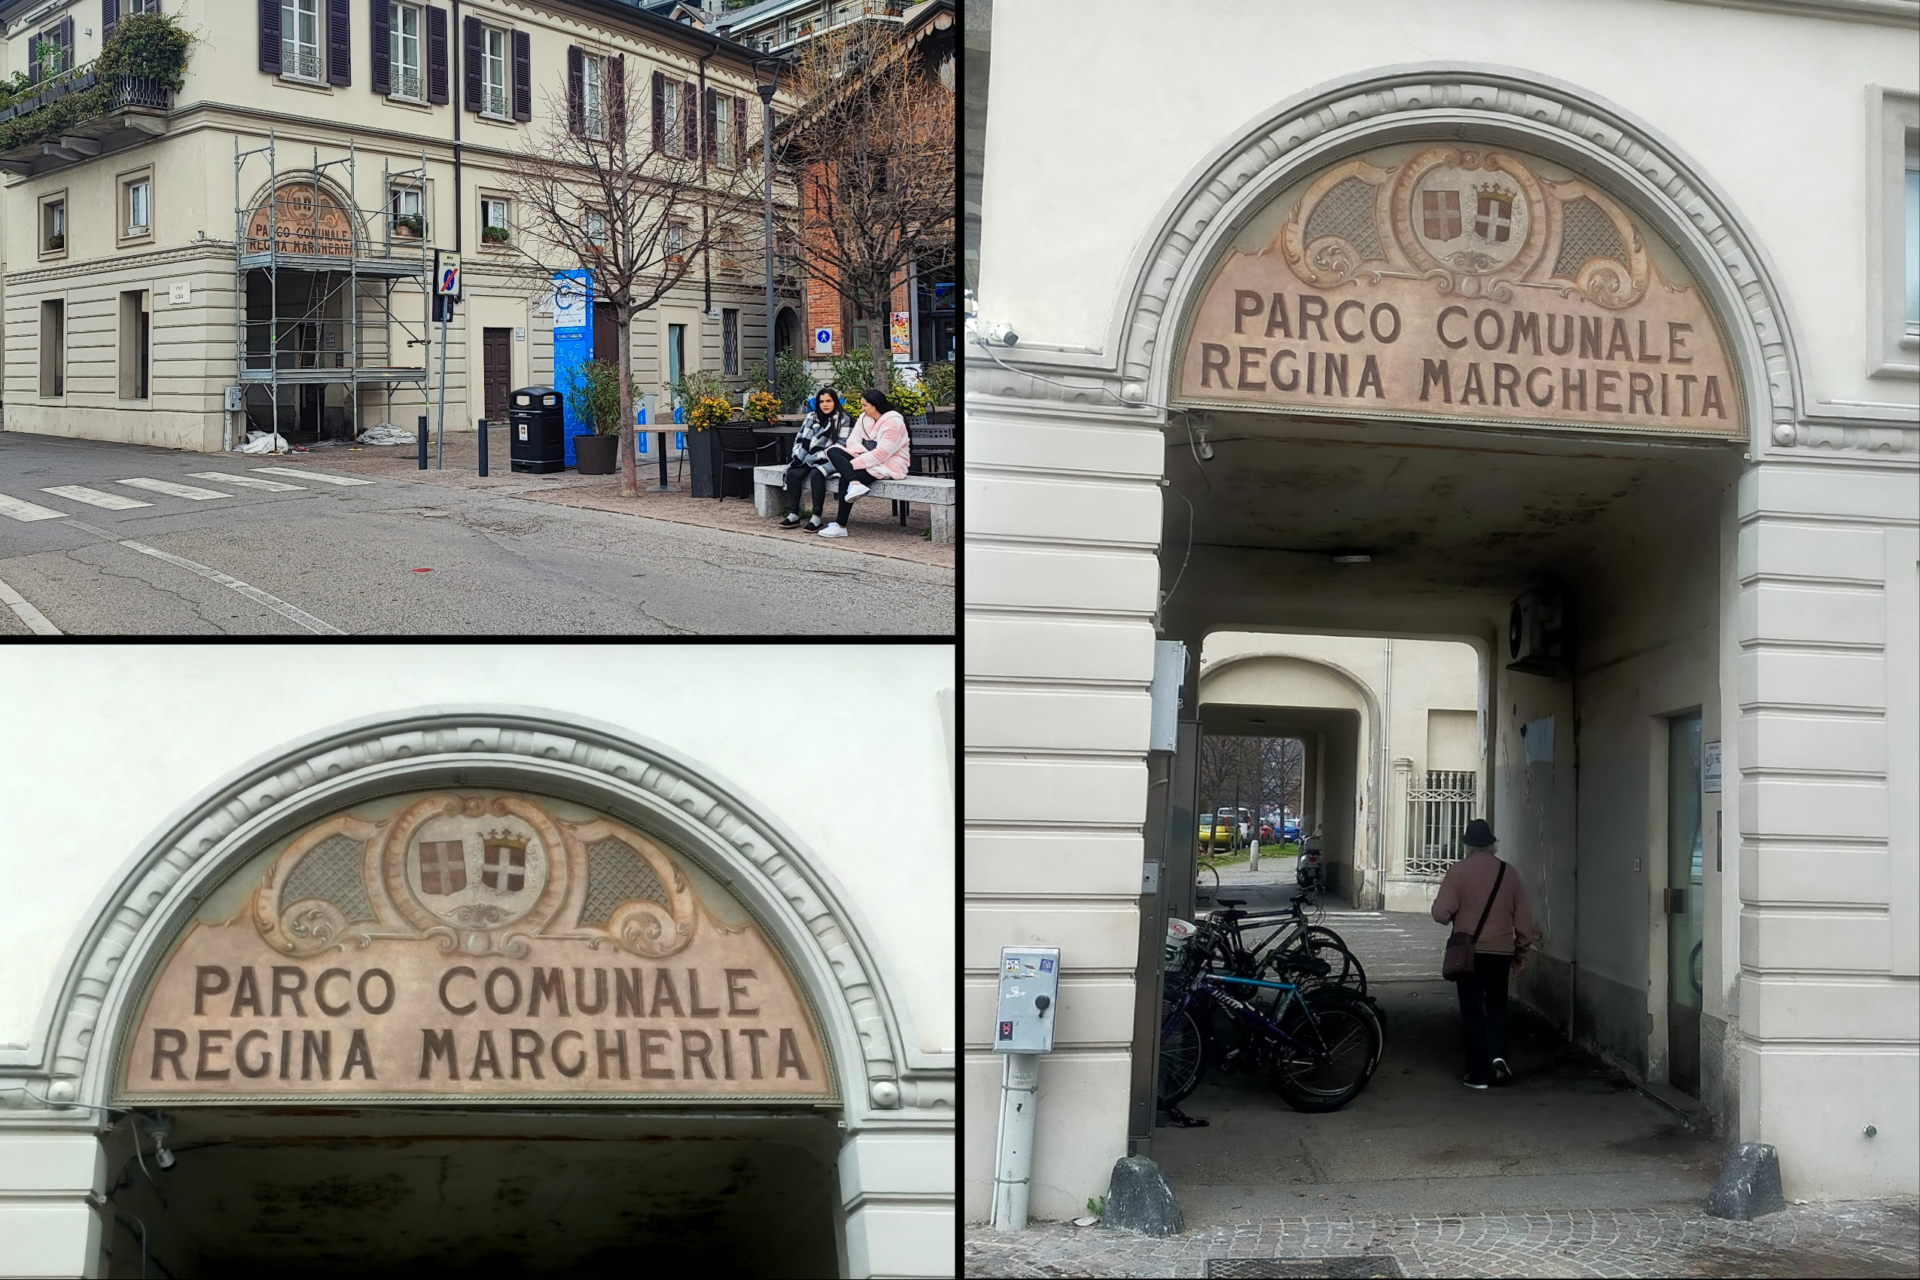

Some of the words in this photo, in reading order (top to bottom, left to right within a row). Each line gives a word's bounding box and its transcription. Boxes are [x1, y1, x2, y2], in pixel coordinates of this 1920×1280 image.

[256, 224, 289, 237] PACO
[1234, 289, 1401, 344] PARCO
[1437, 305, 1694, 365] COMUNALE
[1200, 342, 1386, 399] REGINA
[1419, 358, 1727, 420] MARGHERITA
[194, 965, 397, 1017] PARCO
[438, 966, 762, 1018] COMUNALE
[150, 1028, 377, 1080] REGINA
[418, 1028, 811, 1081] MARGHERITA
